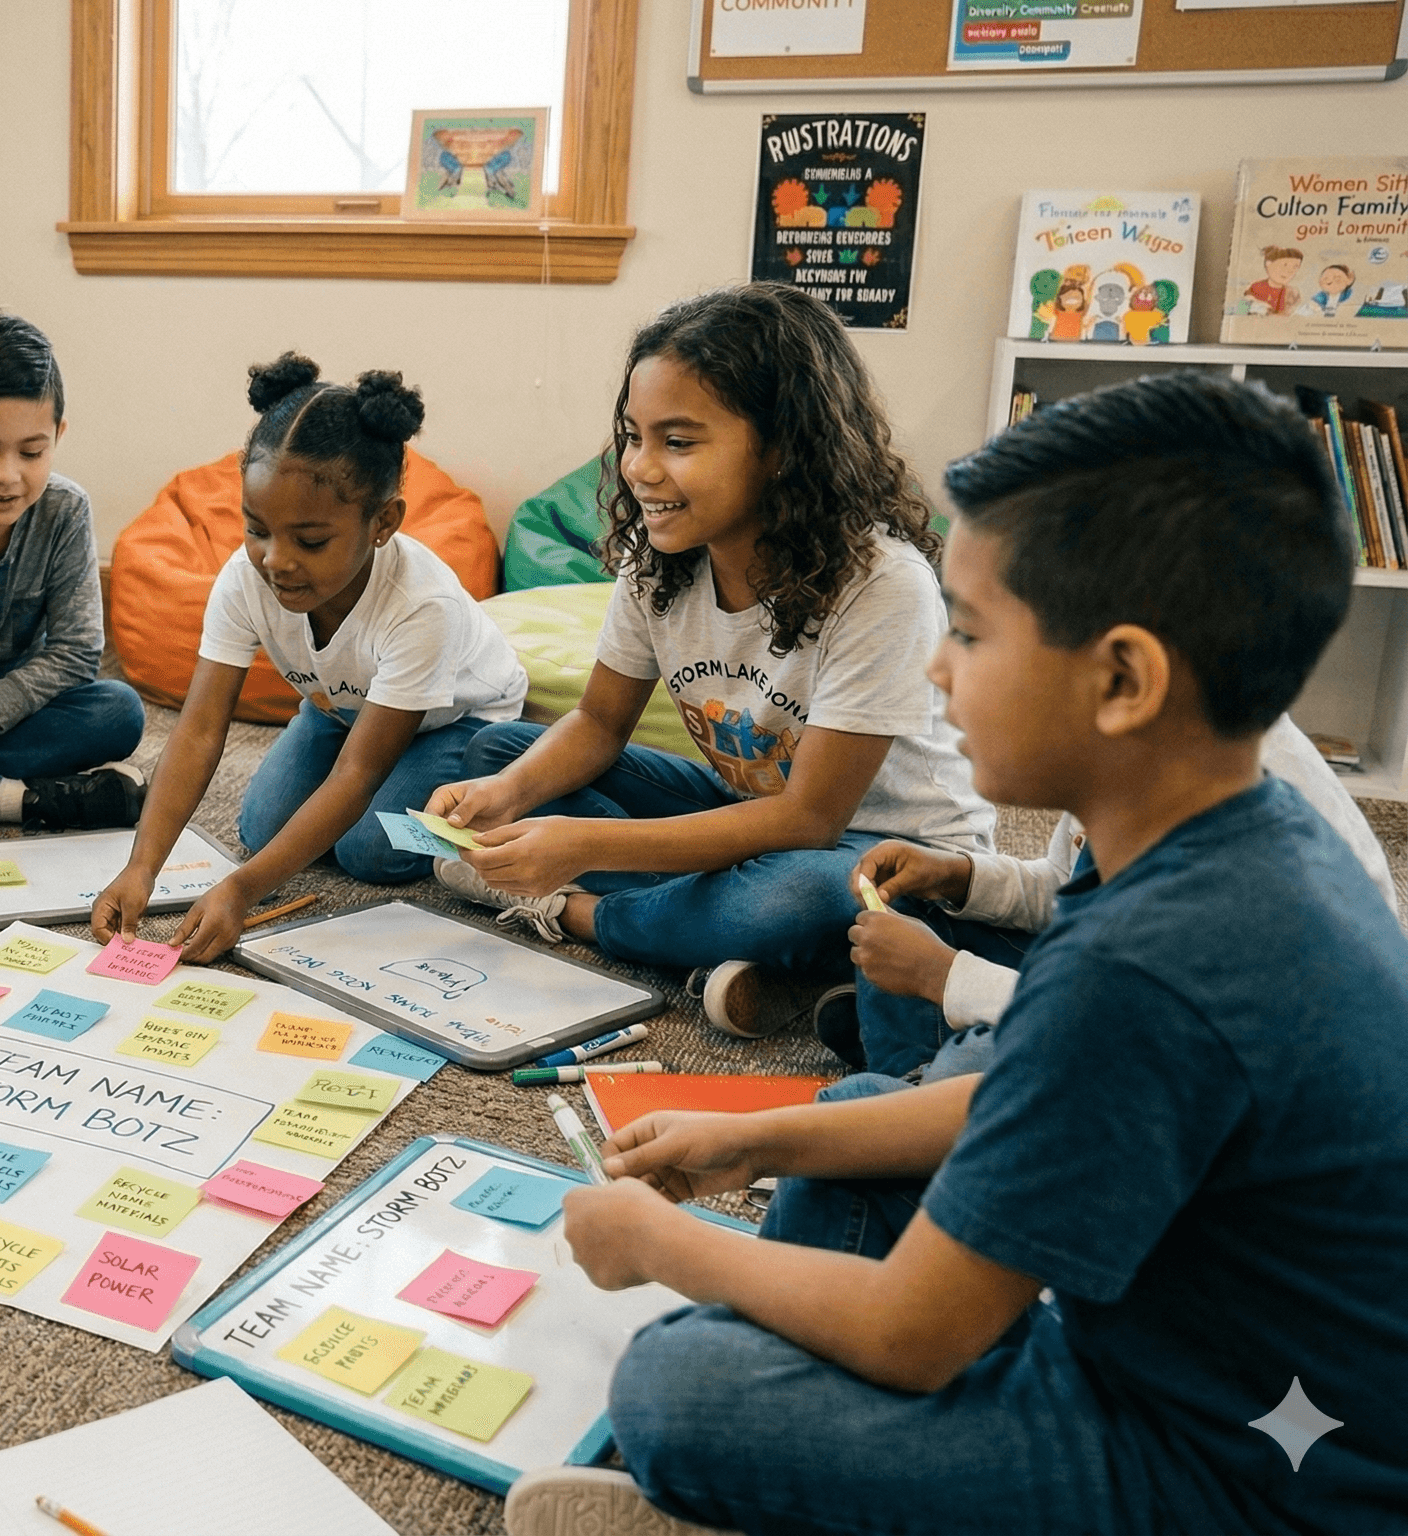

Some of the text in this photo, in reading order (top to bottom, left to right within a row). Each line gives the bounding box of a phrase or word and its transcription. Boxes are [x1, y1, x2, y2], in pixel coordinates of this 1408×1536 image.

[1289, 174, 1369, 193] Women
[1257, 194, 1408, 218] Culton Family
[725, 663, 768, 692] LAKE
[89, 1076, 223, 1122] NAME:
[82, 1108, 200, 1156] BOTZ
[113, 1178, 172, 1200] RECYCLE
[96, 1200, 169, 1227] MATERIALS
[98, 1251, 160, 1281] SOLAR
[223, 1297, 302, 1348] TEAM
[290, 1240, 370, 1298] NAME:
[357, 1190, 429, 1240] STORM
[413, 1155, 467, 1192] BOTZ
[87, 1272, 155, 1304] POWER
